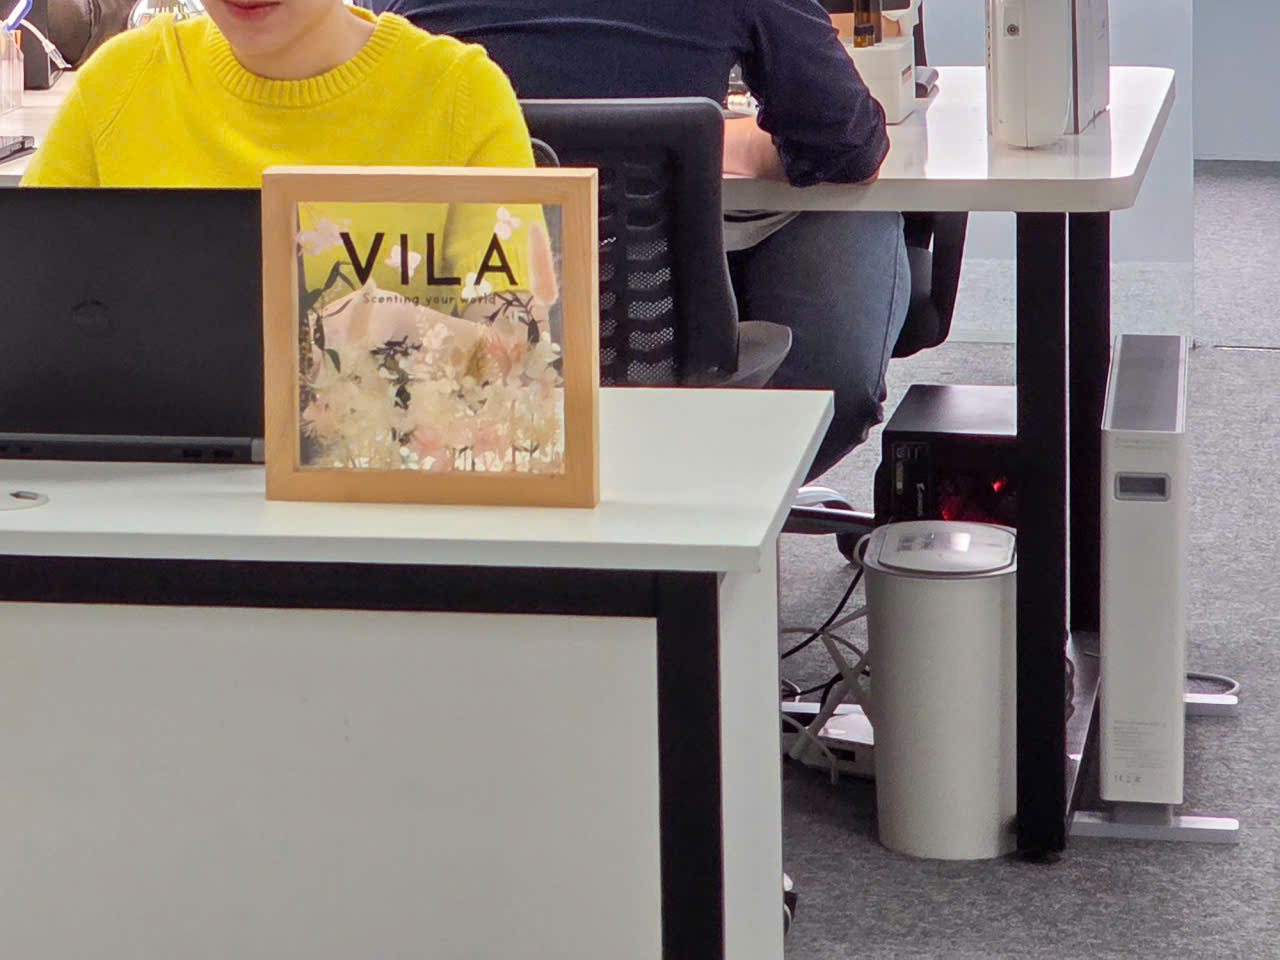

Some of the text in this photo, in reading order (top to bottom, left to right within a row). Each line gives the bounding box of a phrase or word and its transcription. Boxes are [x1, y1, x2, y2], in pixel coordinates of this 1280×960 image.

[339, 231, 519, 286] VILA
[362, 292, 496, 306] Scenting your world
